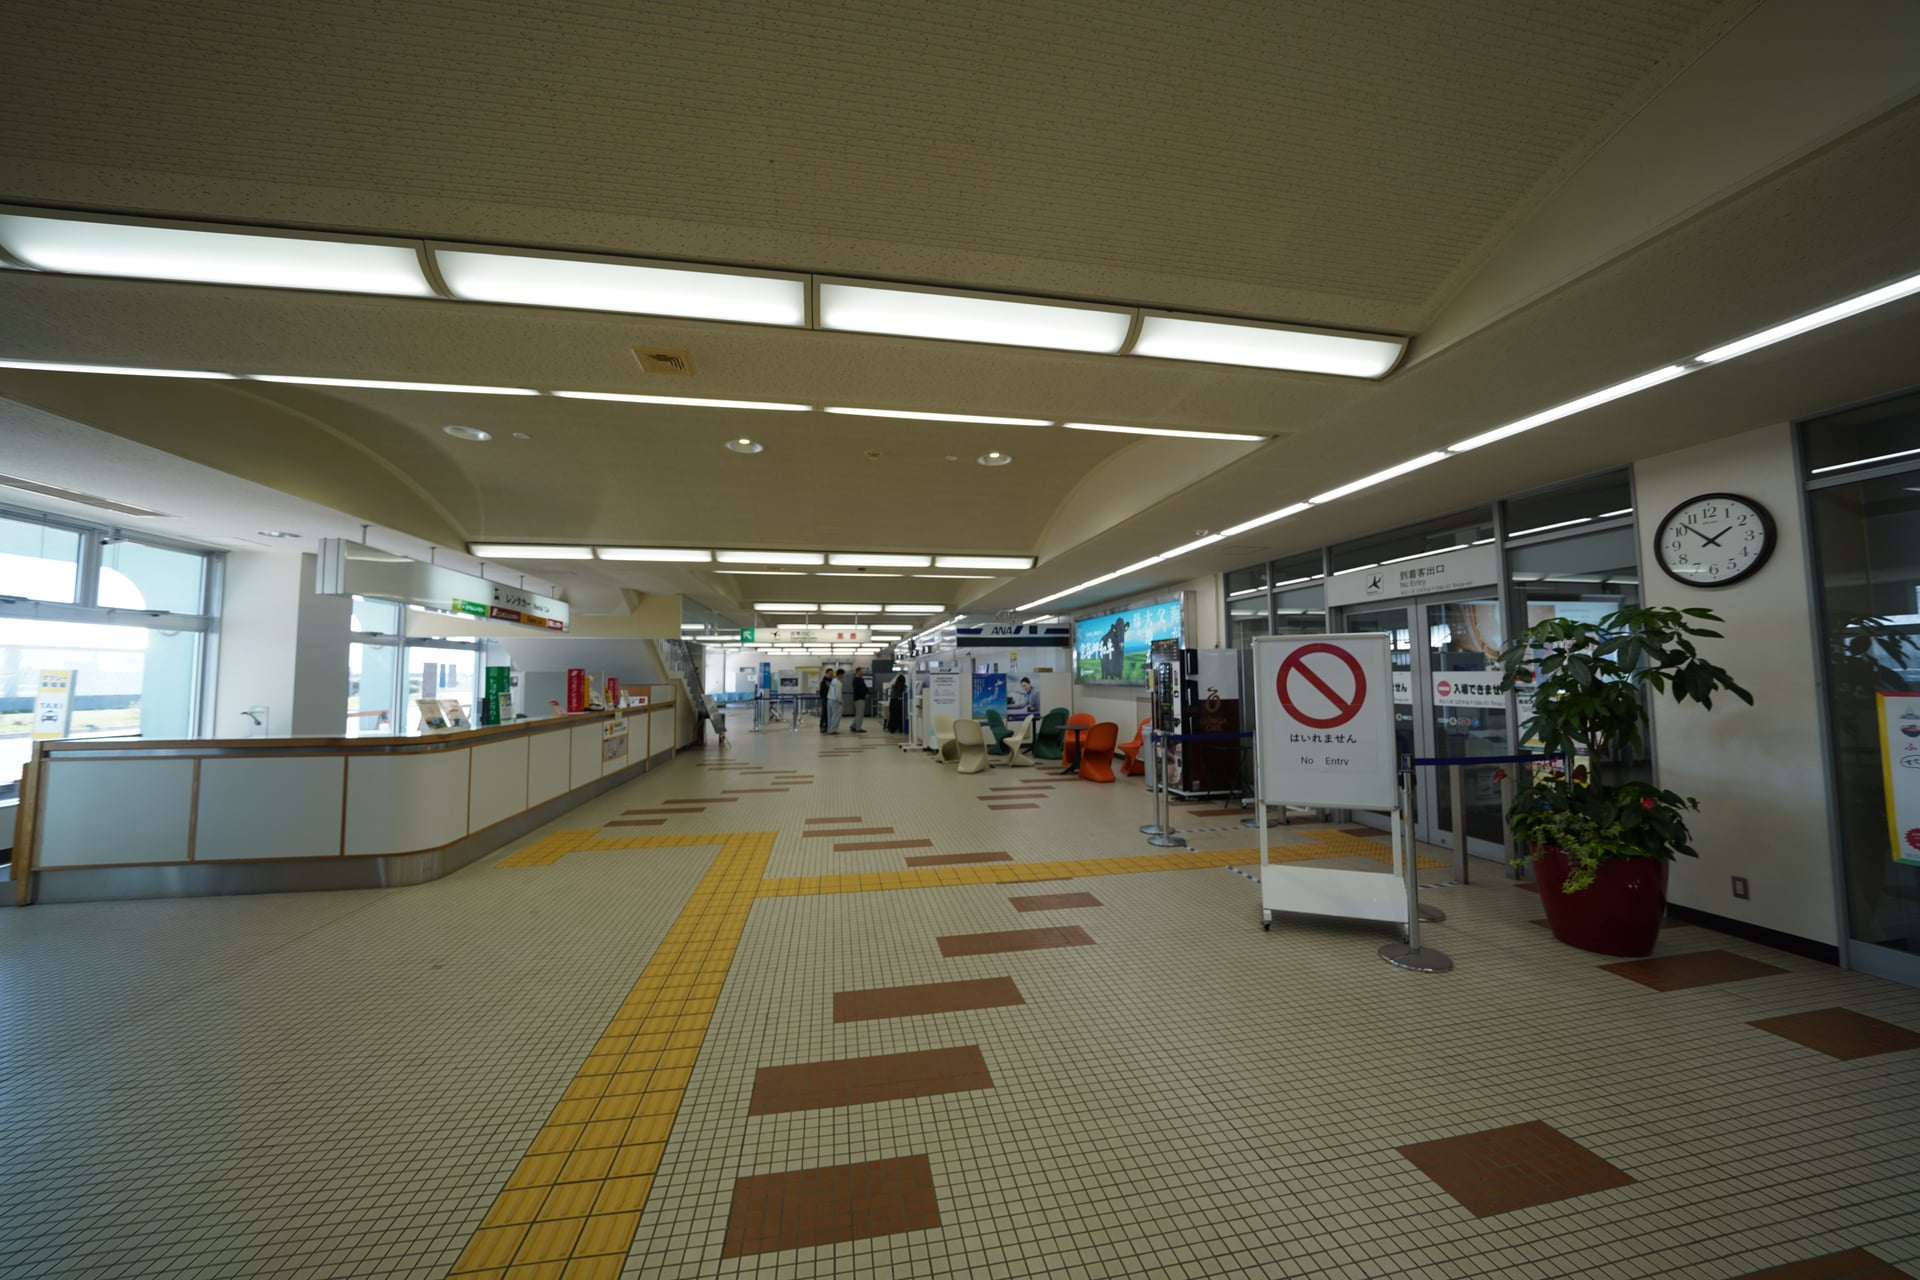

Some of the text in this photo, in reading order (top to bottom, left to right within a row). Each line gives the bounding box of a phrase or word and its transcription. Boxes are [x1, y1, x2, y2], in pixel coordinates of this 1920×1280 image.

[1703, 506, 1717, 519] 12
[1725, 508, 1729, 519] 1
[1687, 513, 1697, 525] 11
[1737, 514, 1747, 526] 2
[1675, 526, 1688, 537] 10
[1744, 530, 1755, 541] 3
[1672, 540, 1681, 552] 9
[1739, 545, 1749, 557] 4
[1678, 554, 1688, 565] 8
[1727, 558, 1737, 570] 5
[1400, 564, 1445, 580] 到着客出口
[1692, 562, 1701, 574] 7
[1709, 564, 1719, 575] 6
[991, 626, 1013, 635] ANA
[1453, 683, 1504, 695] 入場できませ
[1289, 733, 1357, 744] はいれません
[1300, 756, 1349, 766] No Entry
